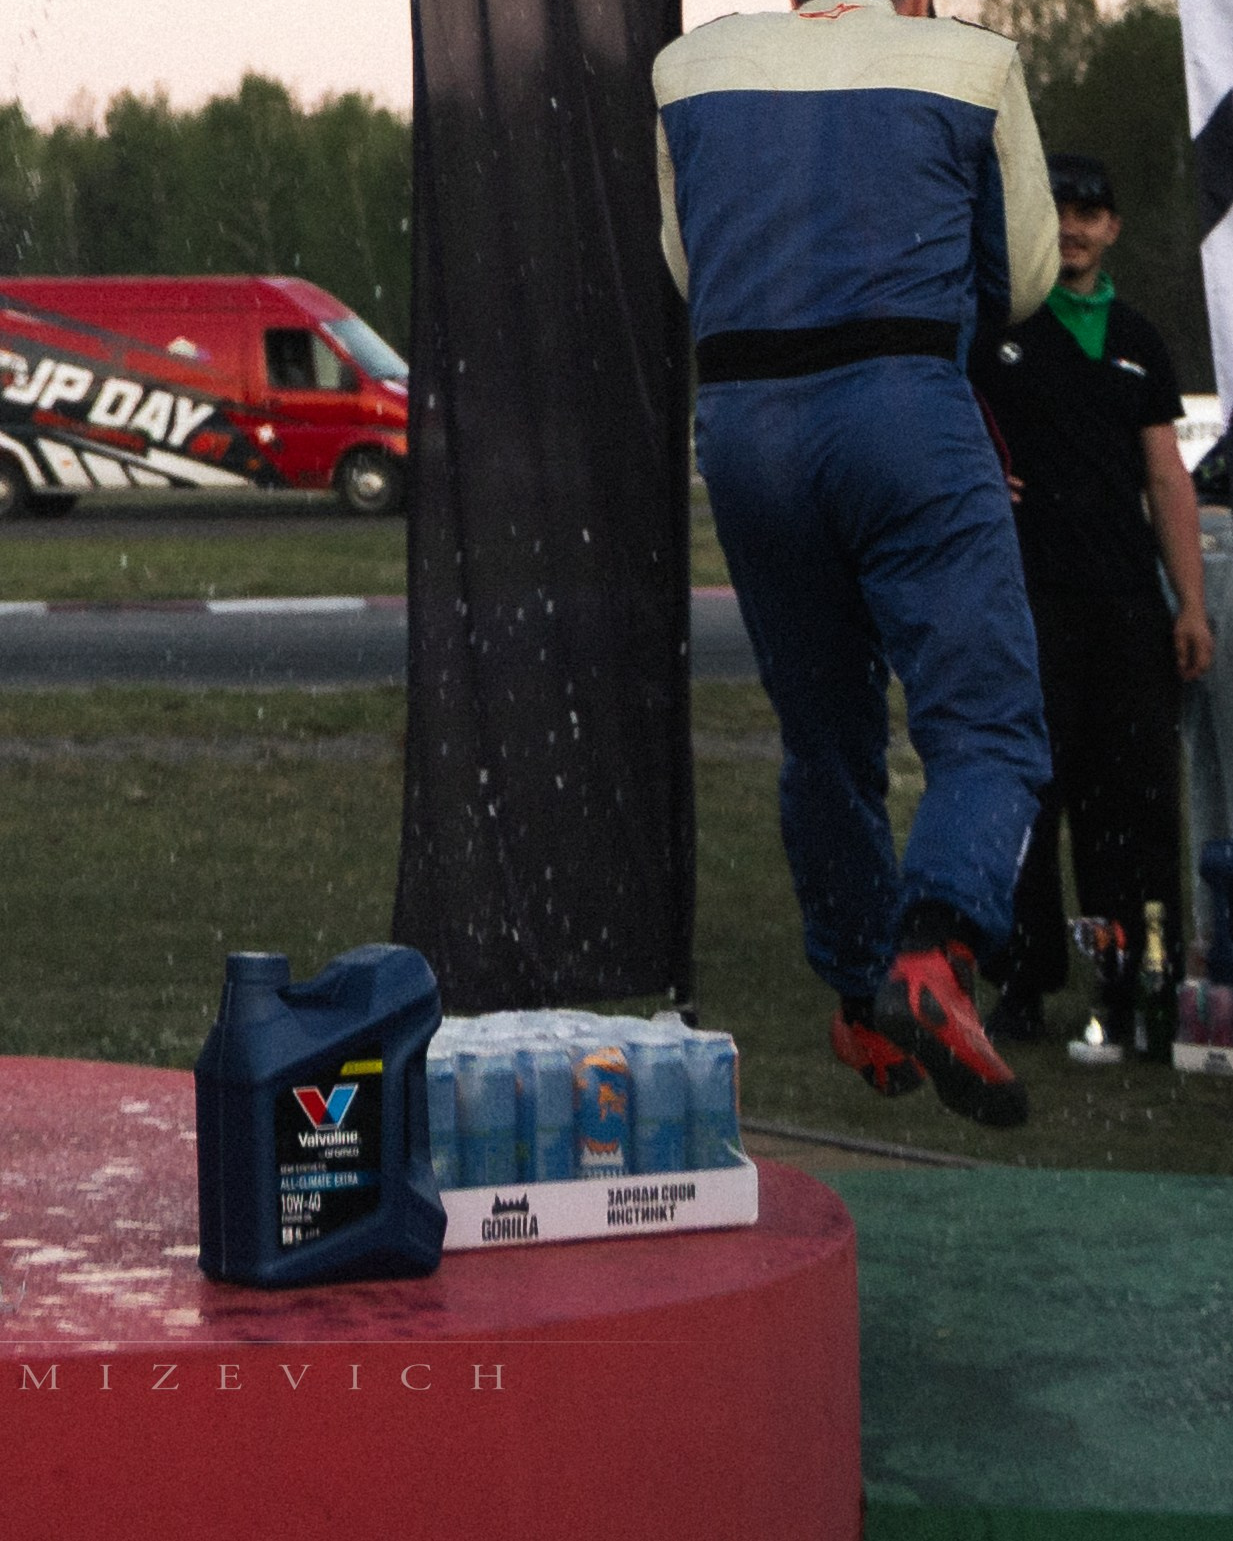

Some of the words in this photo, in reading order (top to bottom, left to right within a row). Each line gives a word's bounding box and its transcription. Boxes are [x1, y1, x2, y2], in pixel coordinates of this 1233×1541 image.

[87, 375, 216, 446] DAY
[298, 1129, 359, 1147] Valvoline
[482, 1214, 539, 1241] GORILLA
